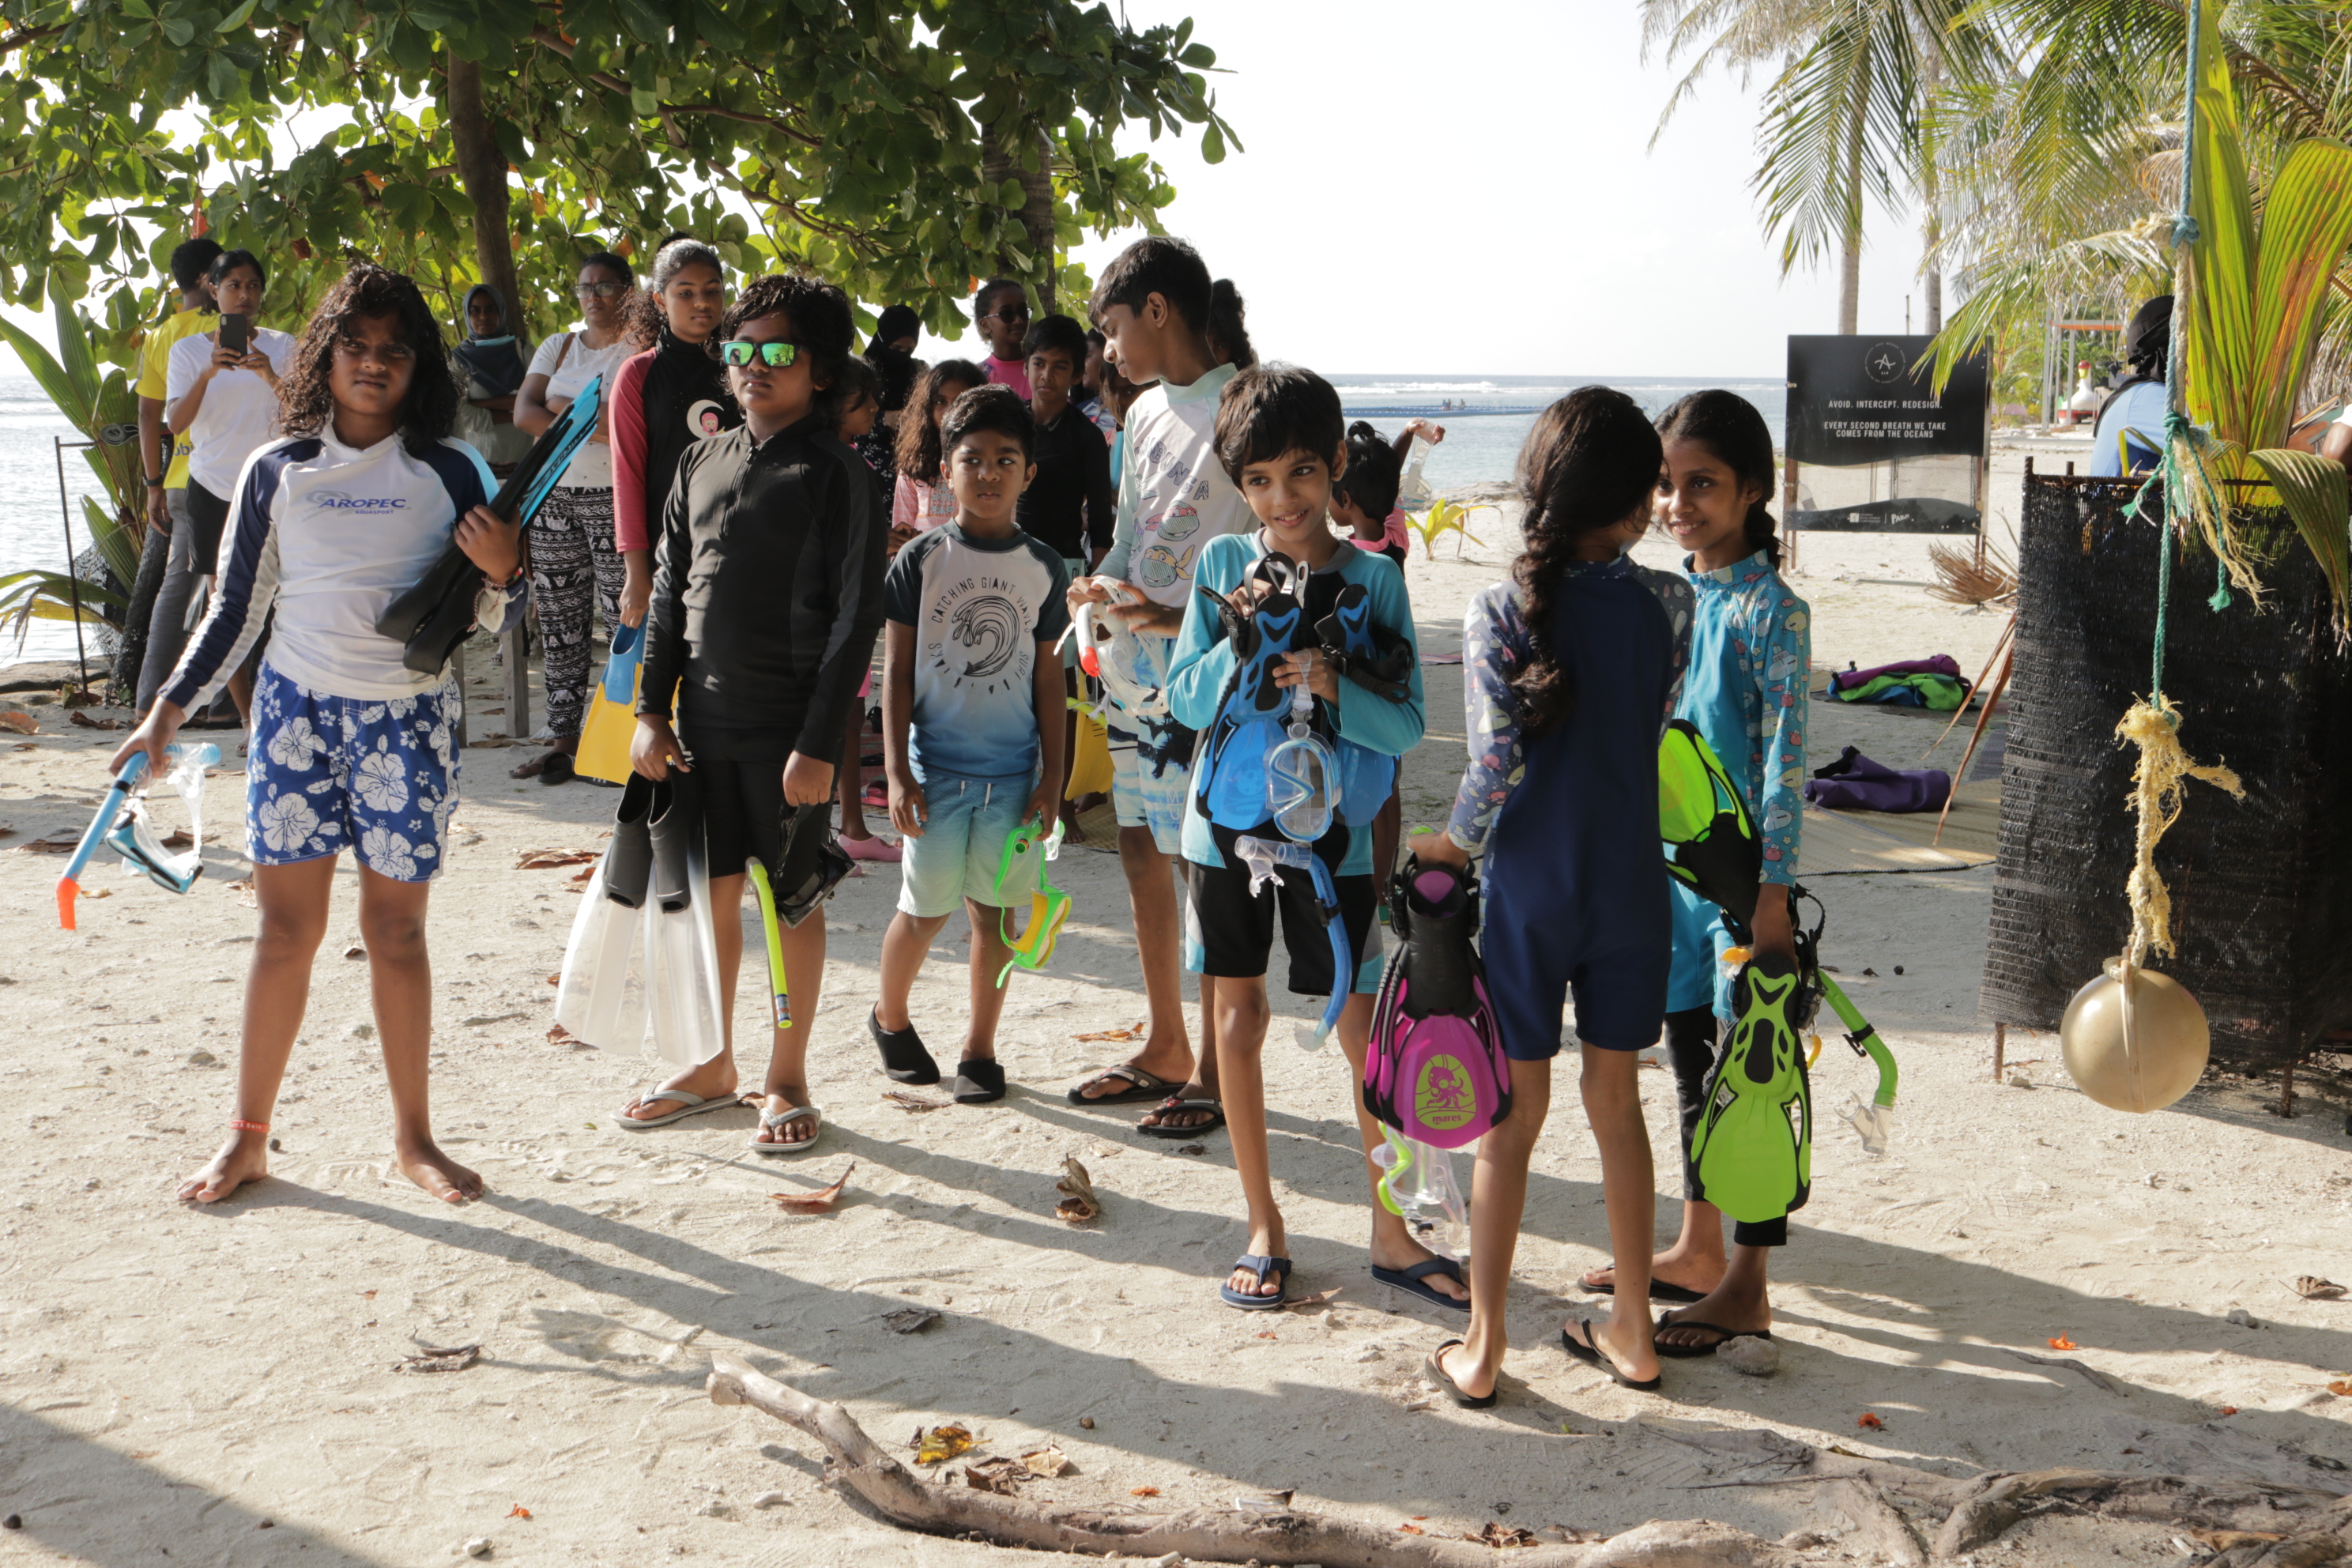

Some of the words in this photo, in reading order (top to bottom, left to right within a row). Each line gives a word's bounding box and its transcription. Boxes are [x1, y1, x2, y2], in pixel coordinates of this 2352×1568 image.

[1828, 400, 1853, 409] AVOID.
[1856, 400, 1899, 409] INTERCEPT.
[1902, 400, 1943, 409] REDESIGN.
[1850, 421, 1879, 430] SECOND
[1883, 421, 1912, 430] BREATH
[318, 498, 406, 508] AROPEC
[932, 578, 974, 623] CATCHING
[982, 577, 1016, 595] GIANT
[1432, 1115, 1461, 1125] mares
